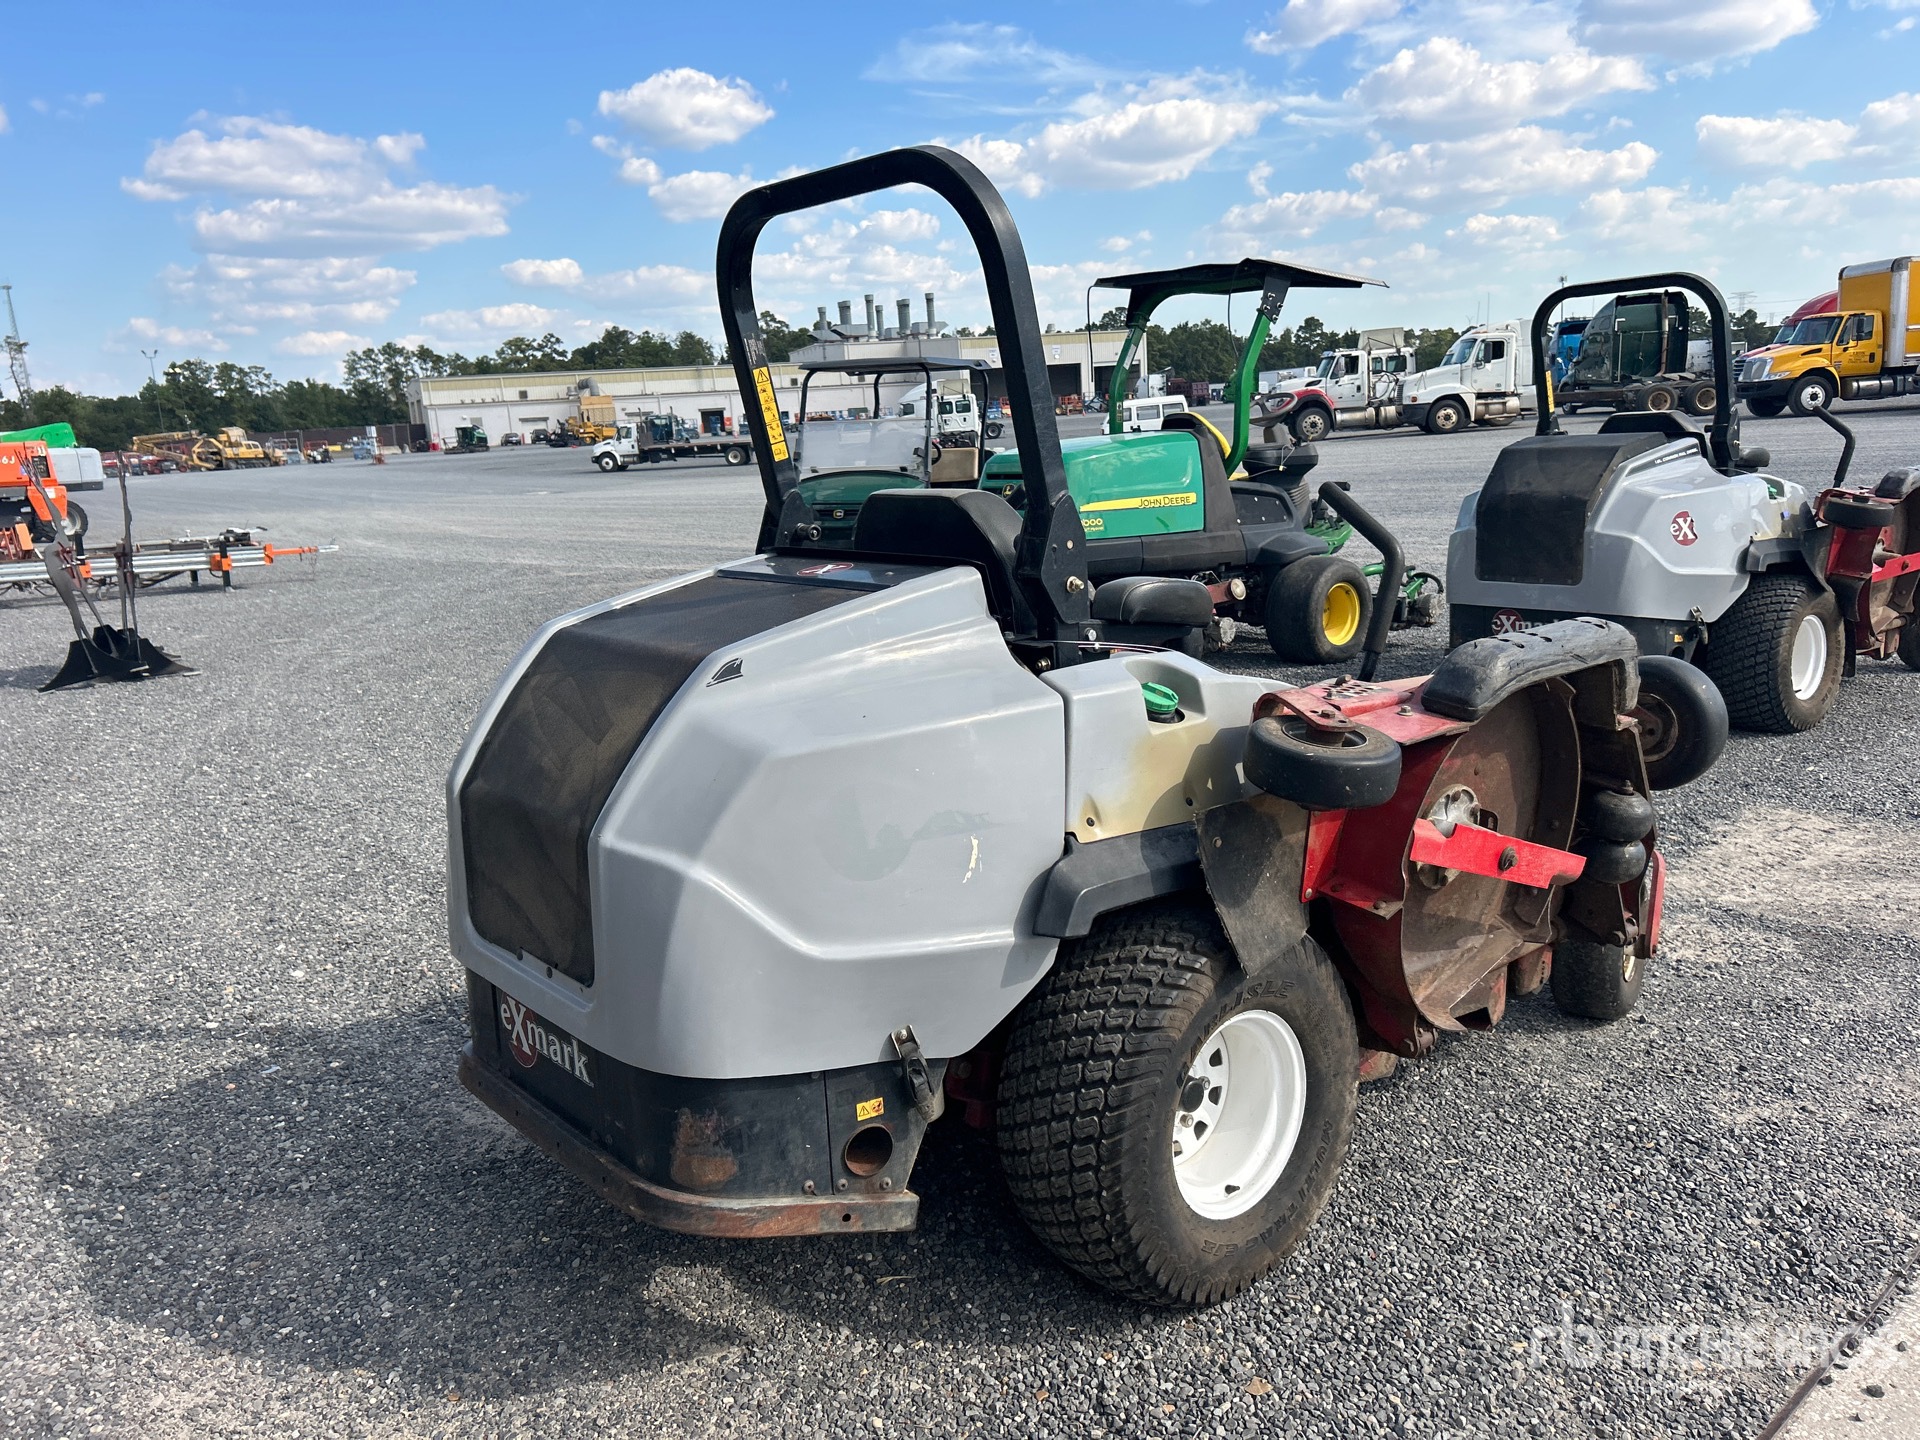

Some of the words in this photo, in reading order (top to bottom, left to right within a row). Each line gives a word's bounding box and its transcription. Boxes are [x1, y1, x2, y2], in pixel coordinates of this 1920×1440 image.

[1138, 498, 1162, 508] JOHN
[1163, 495, 1191, 506] DEERE
[501, 996, 593, 1086] eXmark
